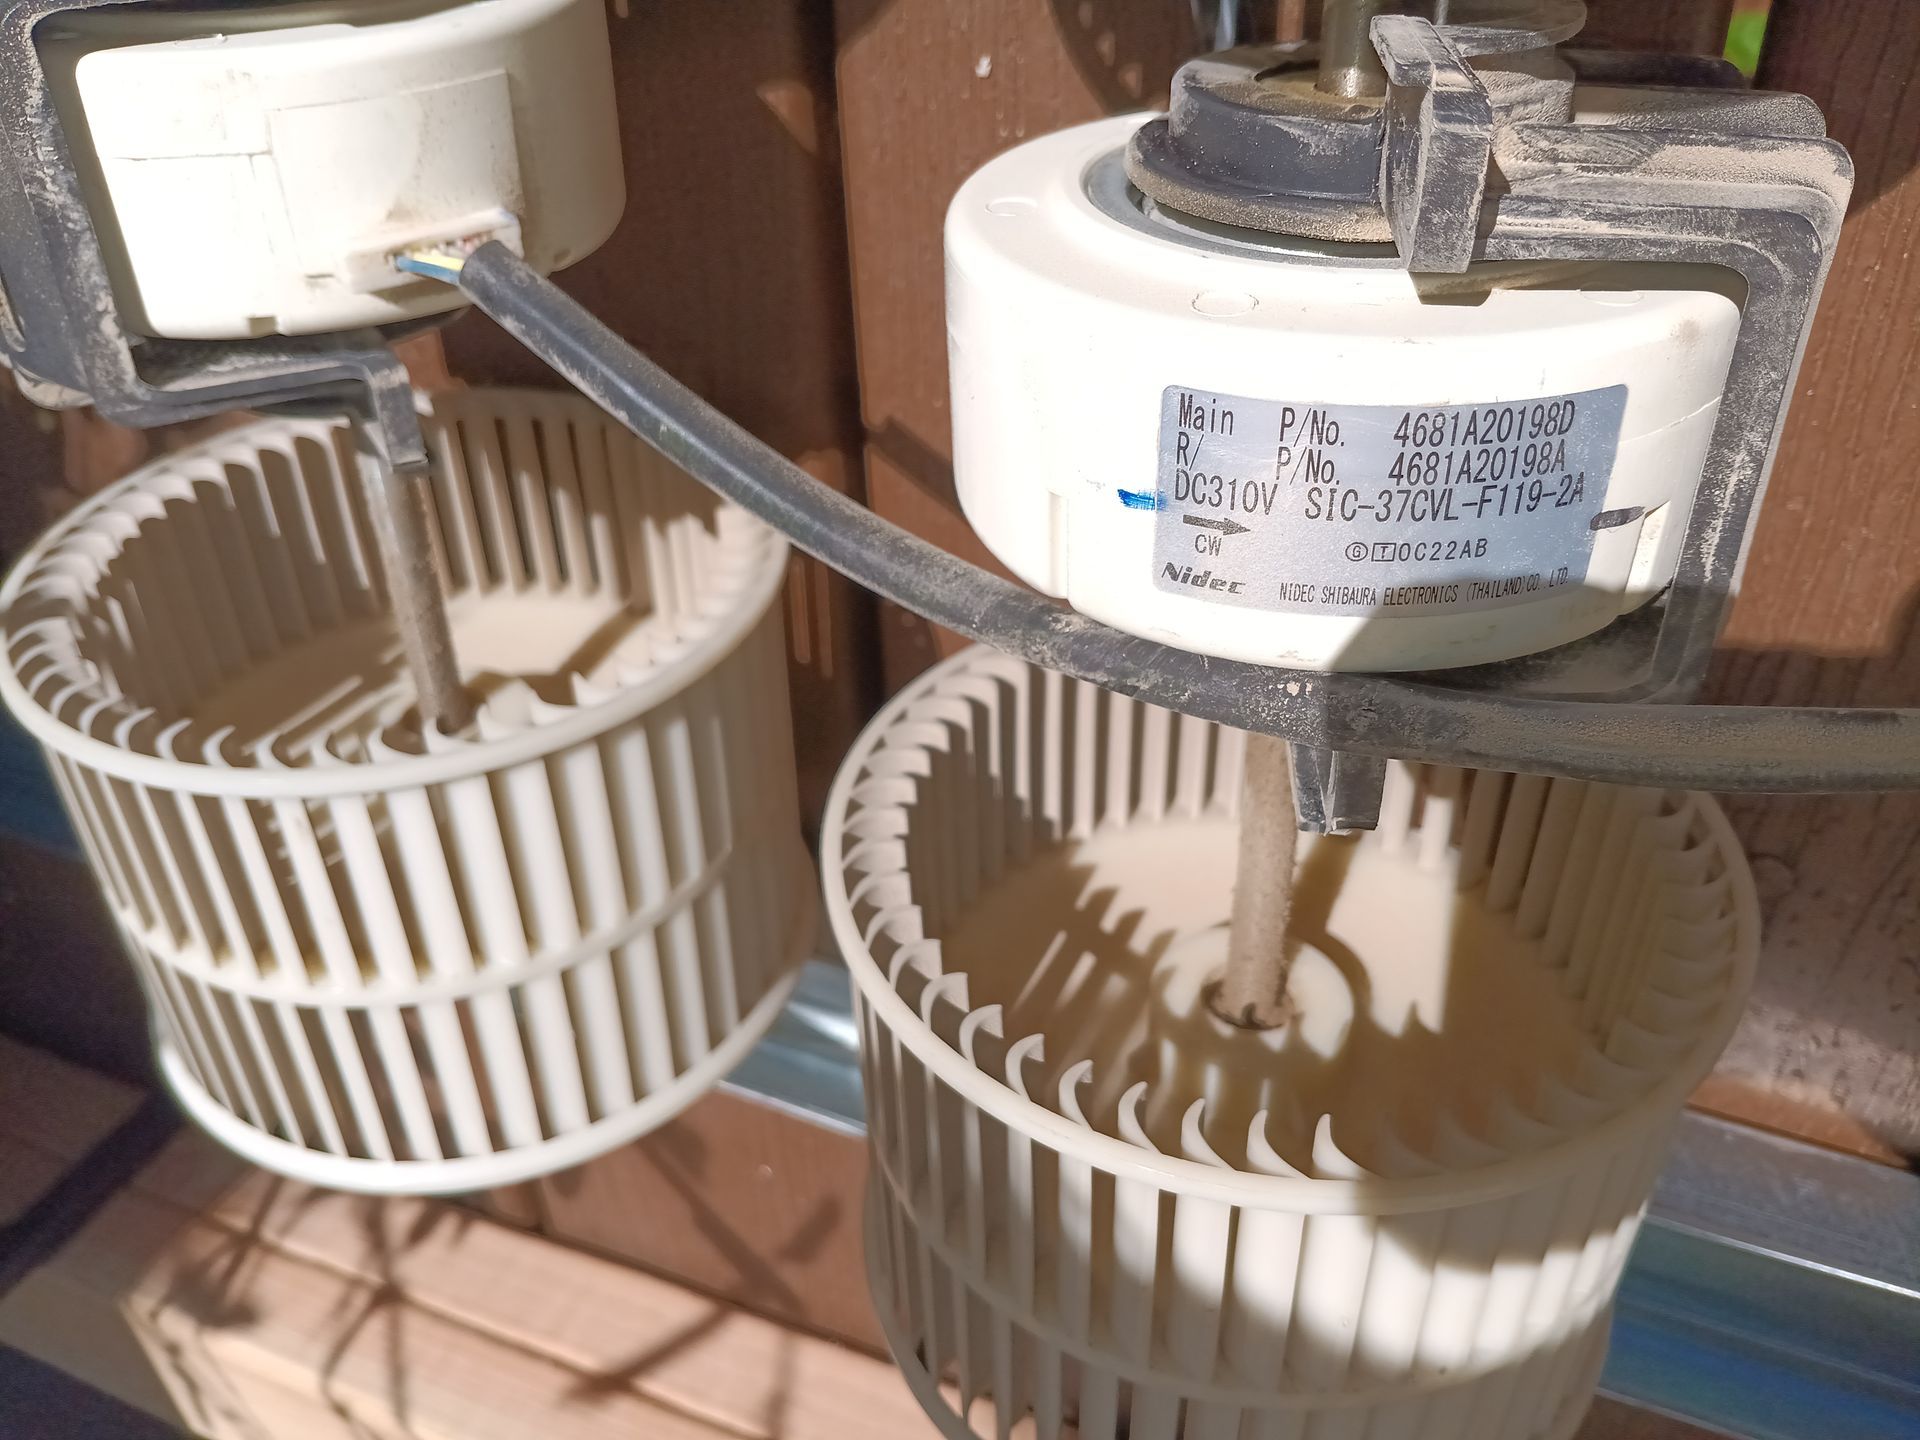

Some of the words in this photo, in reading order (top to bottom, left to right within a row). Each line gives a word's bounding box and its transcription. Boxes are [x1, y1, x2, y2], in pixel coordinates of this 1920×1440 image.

[1178, 393, 1234, 436] Main
[1279, 407, 1345, 447] P/No.
[1393, 400, 1576, 448] 4681A20198D
[1176, 432, 1204, 471] R/
[1276, 446, 1340, 485] P/No.
[1388, 438, 1566, 486] 4681A20198A
[1174, 467, 1279, 515] DC310V
[1304, 471, 1585, 522] SIC-37CVL-F119-2A
[1194, 533, 1223, 557] CW
[1161, 562, 1246, 594] Nidec
[1279, 582, 1316, 604] NIDEC
[1320, 585, 1377, 606] SHIBAURA
[1383, 583, 1459, 606] ELECTRONICS
